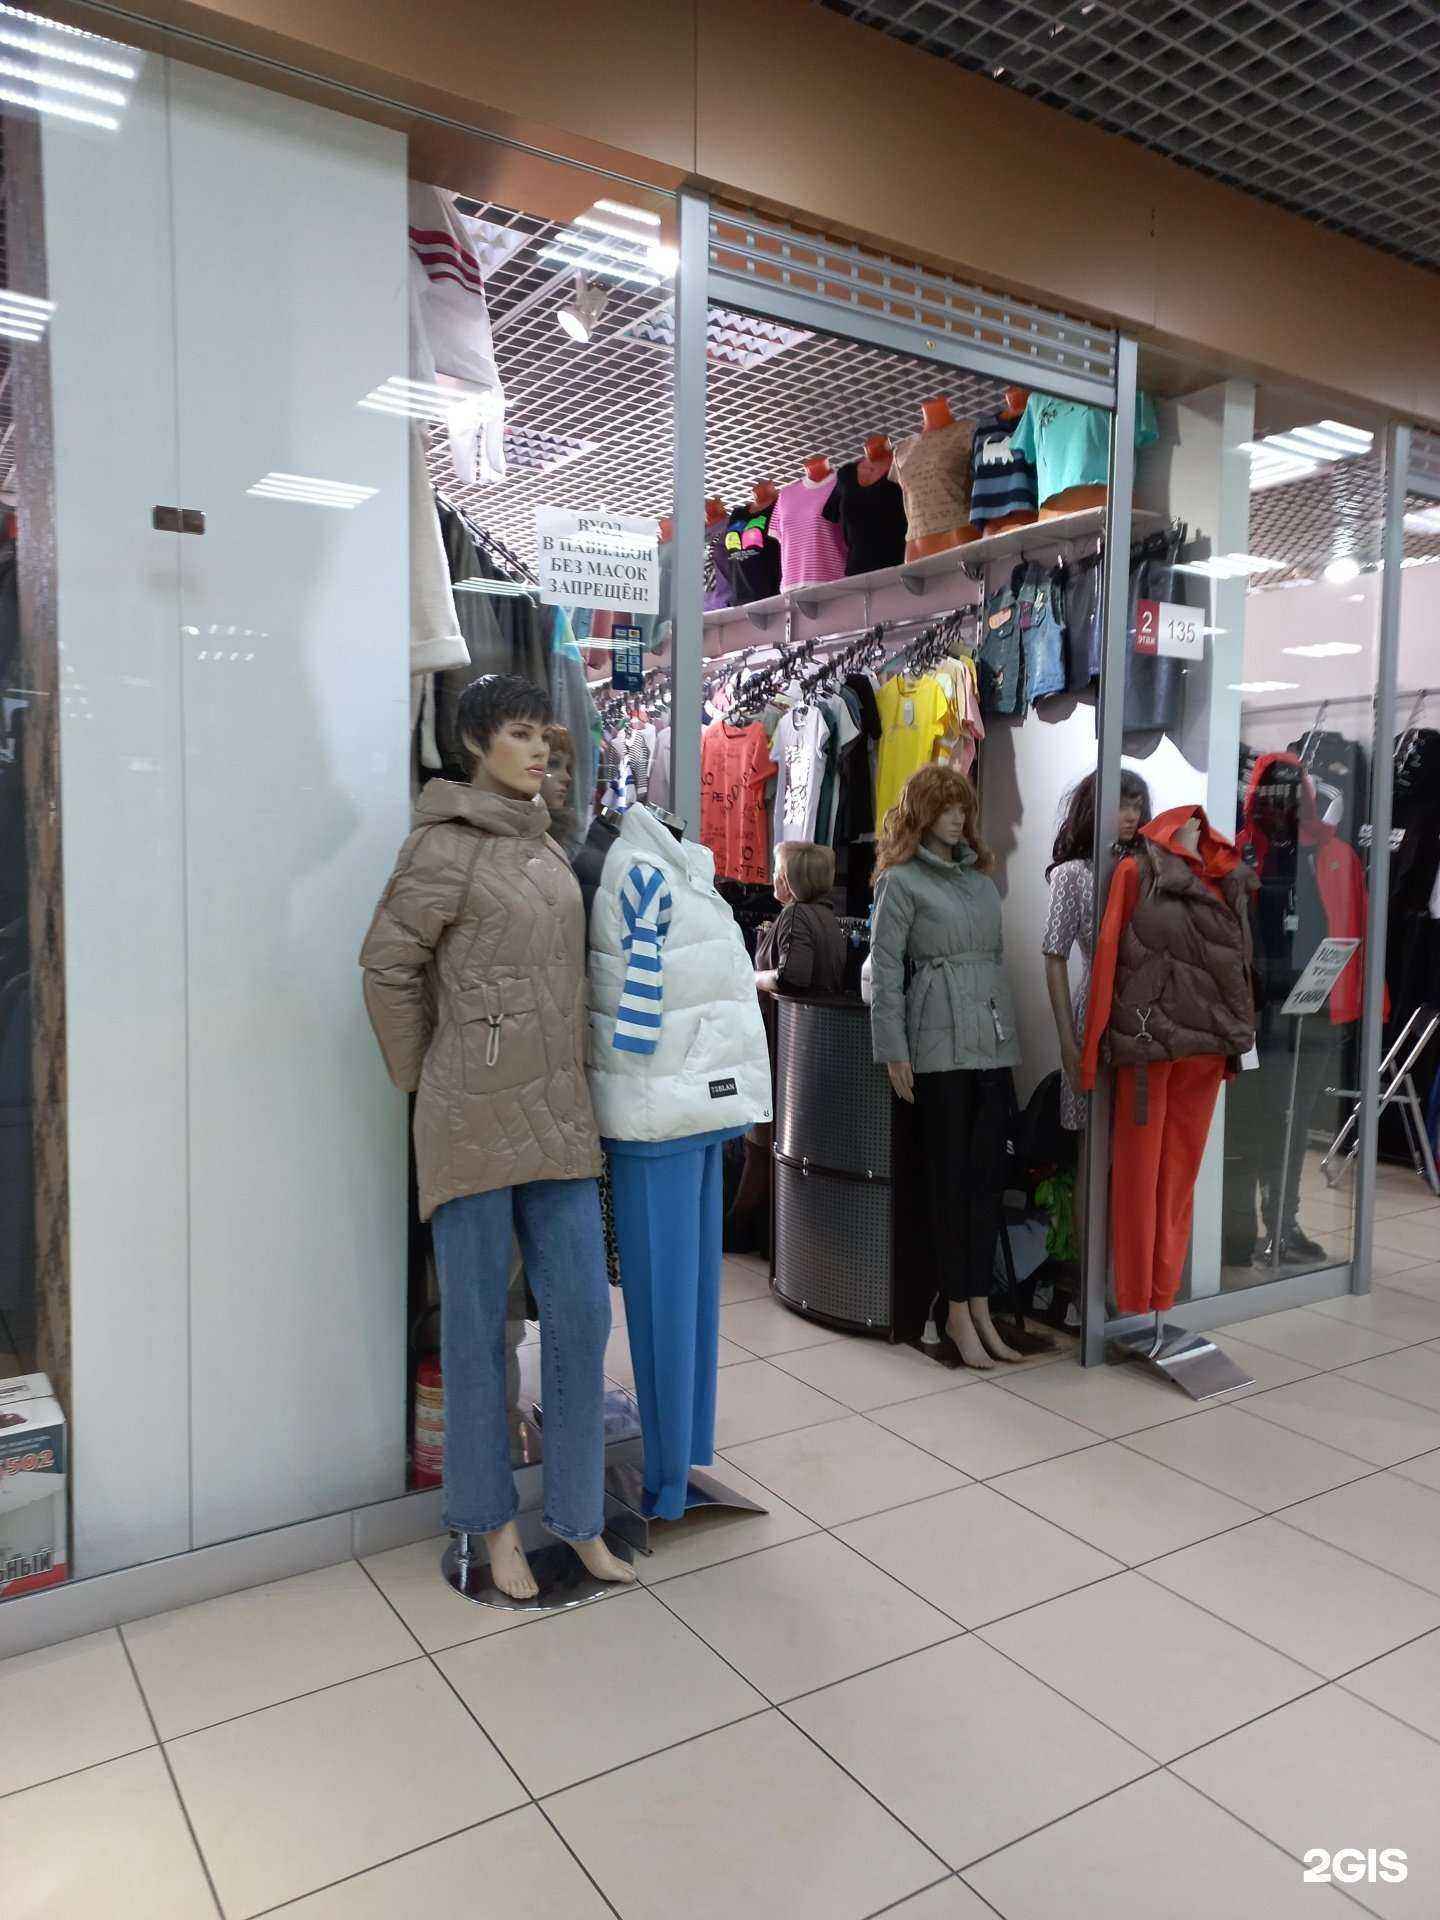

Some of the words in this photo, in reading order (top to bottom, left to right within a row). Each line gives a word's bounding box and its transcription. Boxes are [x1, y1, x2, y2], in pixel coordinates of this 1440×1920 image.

[543, 536, 554, 550] В
[551, 557, 582, 574] БЕЗ
[588, 561, 648, 581] МАСОК
[549, 578, 649, 601] ЗАПРЕЩЁН!
[1142, 611, 1152, 633] 2
[1168, 619, 1196, 643] 135
